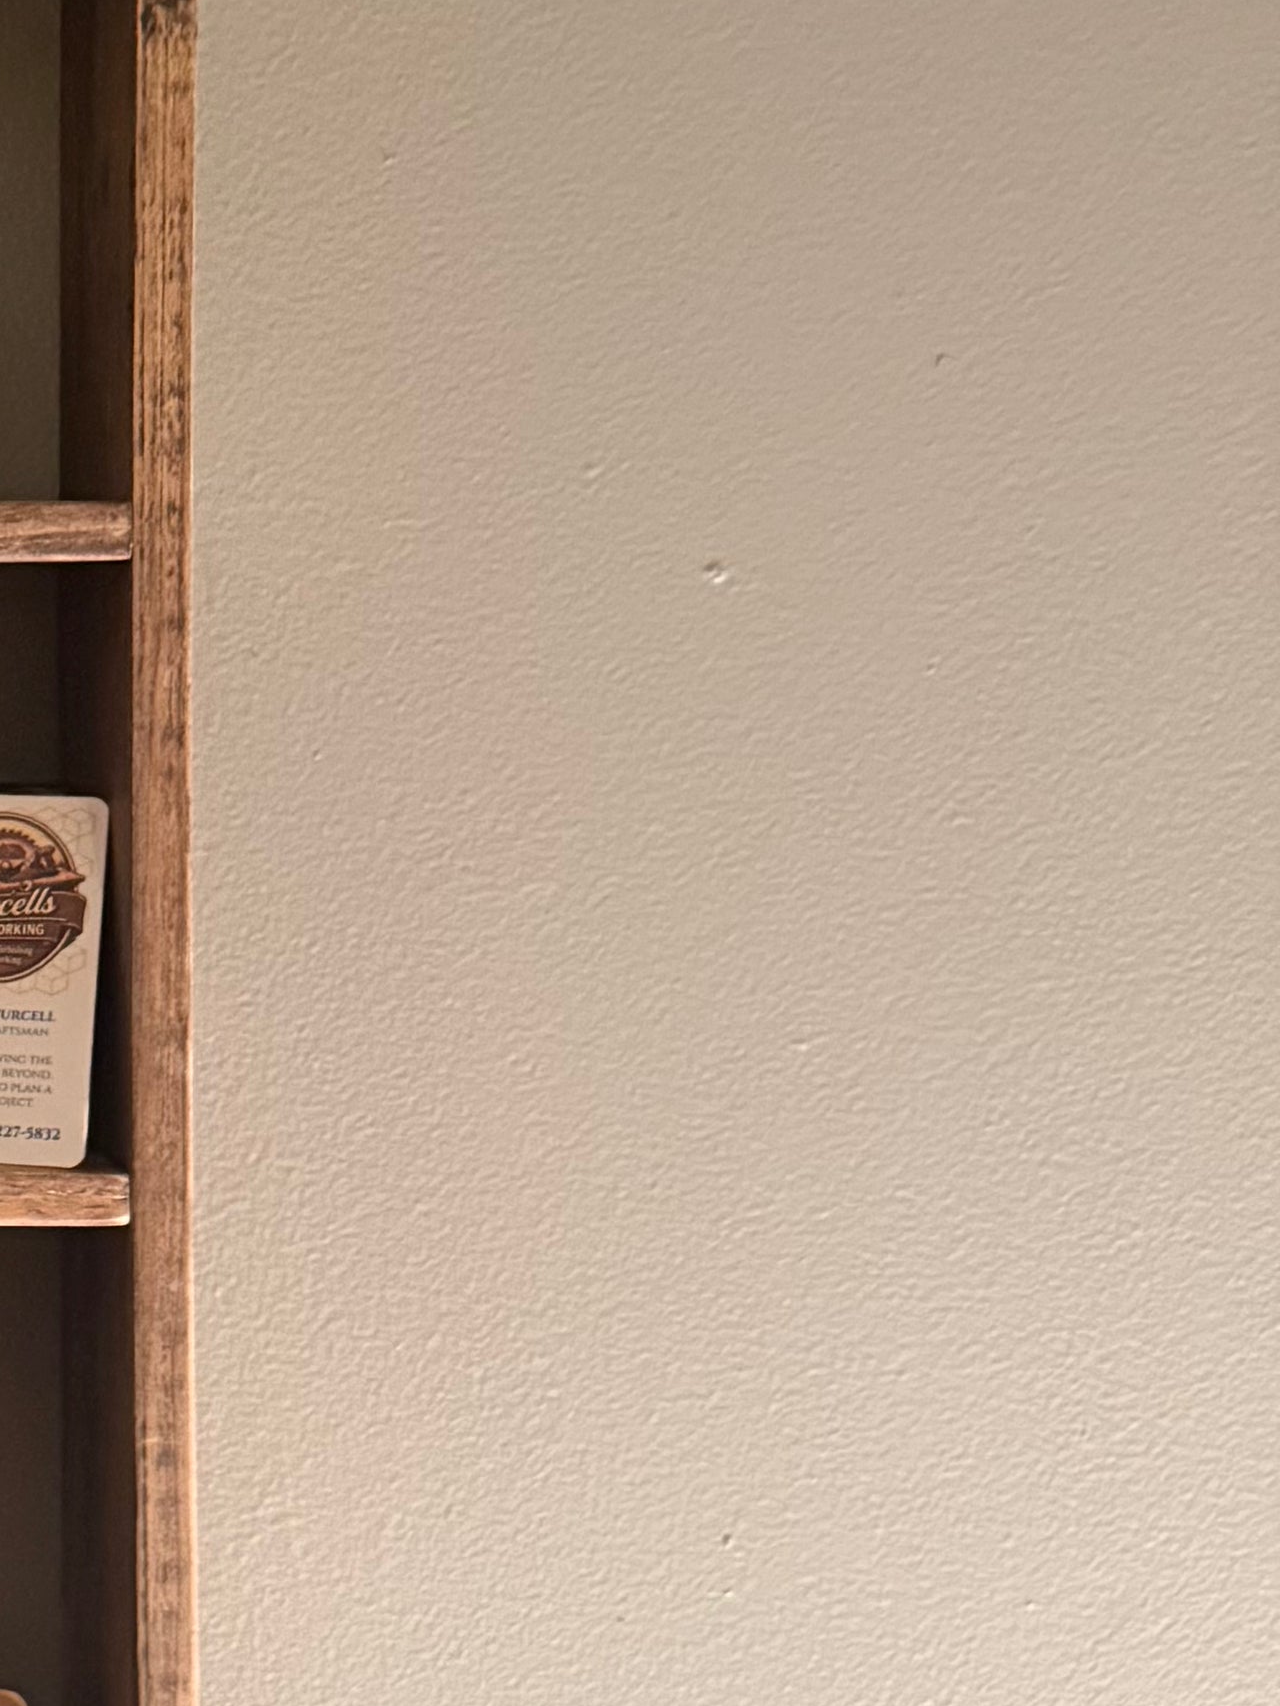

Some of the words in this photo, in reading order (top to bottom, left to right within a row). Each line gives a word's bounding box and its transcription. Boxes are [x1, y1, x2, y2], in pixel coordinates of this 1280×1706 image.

[30, 1055, 53, 1066] THE
[10, 1083, 41, 1094] PLAN
[44, 1086, 52, 1094] A
